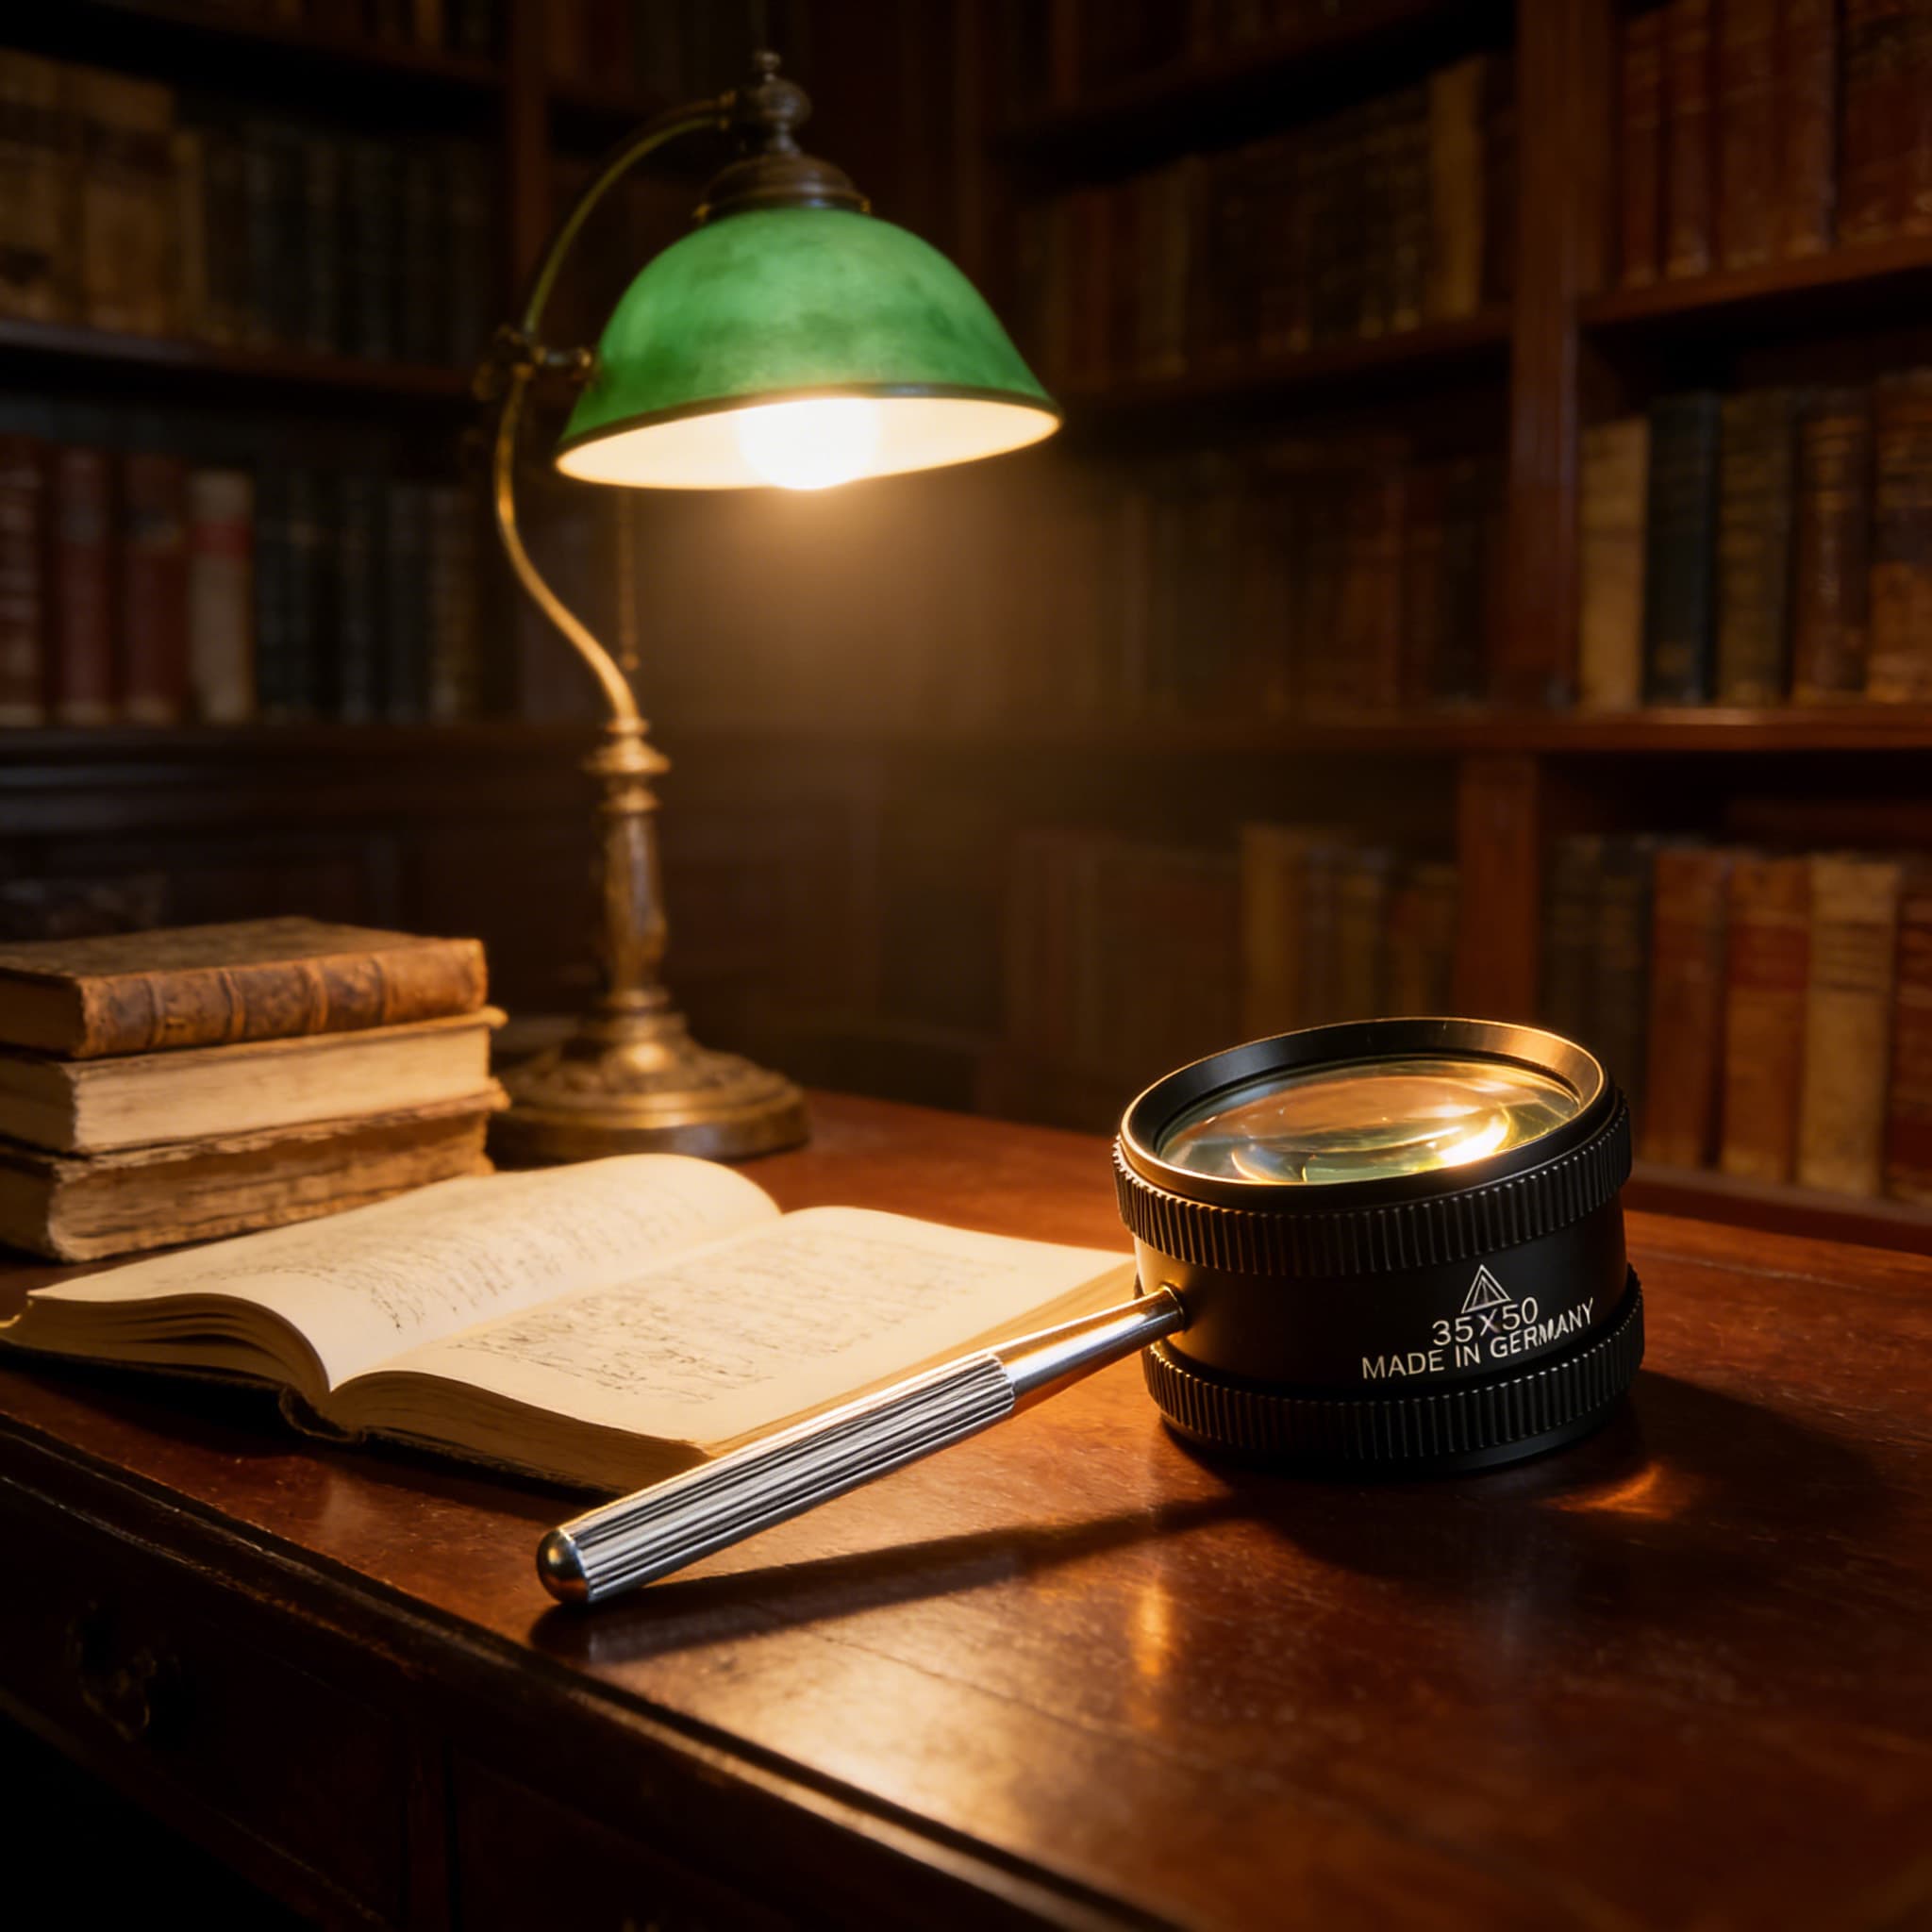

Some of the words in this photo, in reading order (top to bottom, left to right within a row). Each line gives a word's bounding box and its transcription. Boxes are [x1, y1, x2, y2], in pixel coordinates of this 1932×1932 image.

[1361, 1349, 1445, 1380] MADE
[1455, 1342, 1481, 1368] IN
[1490, 1296, 1593, 1358] GERMANY
